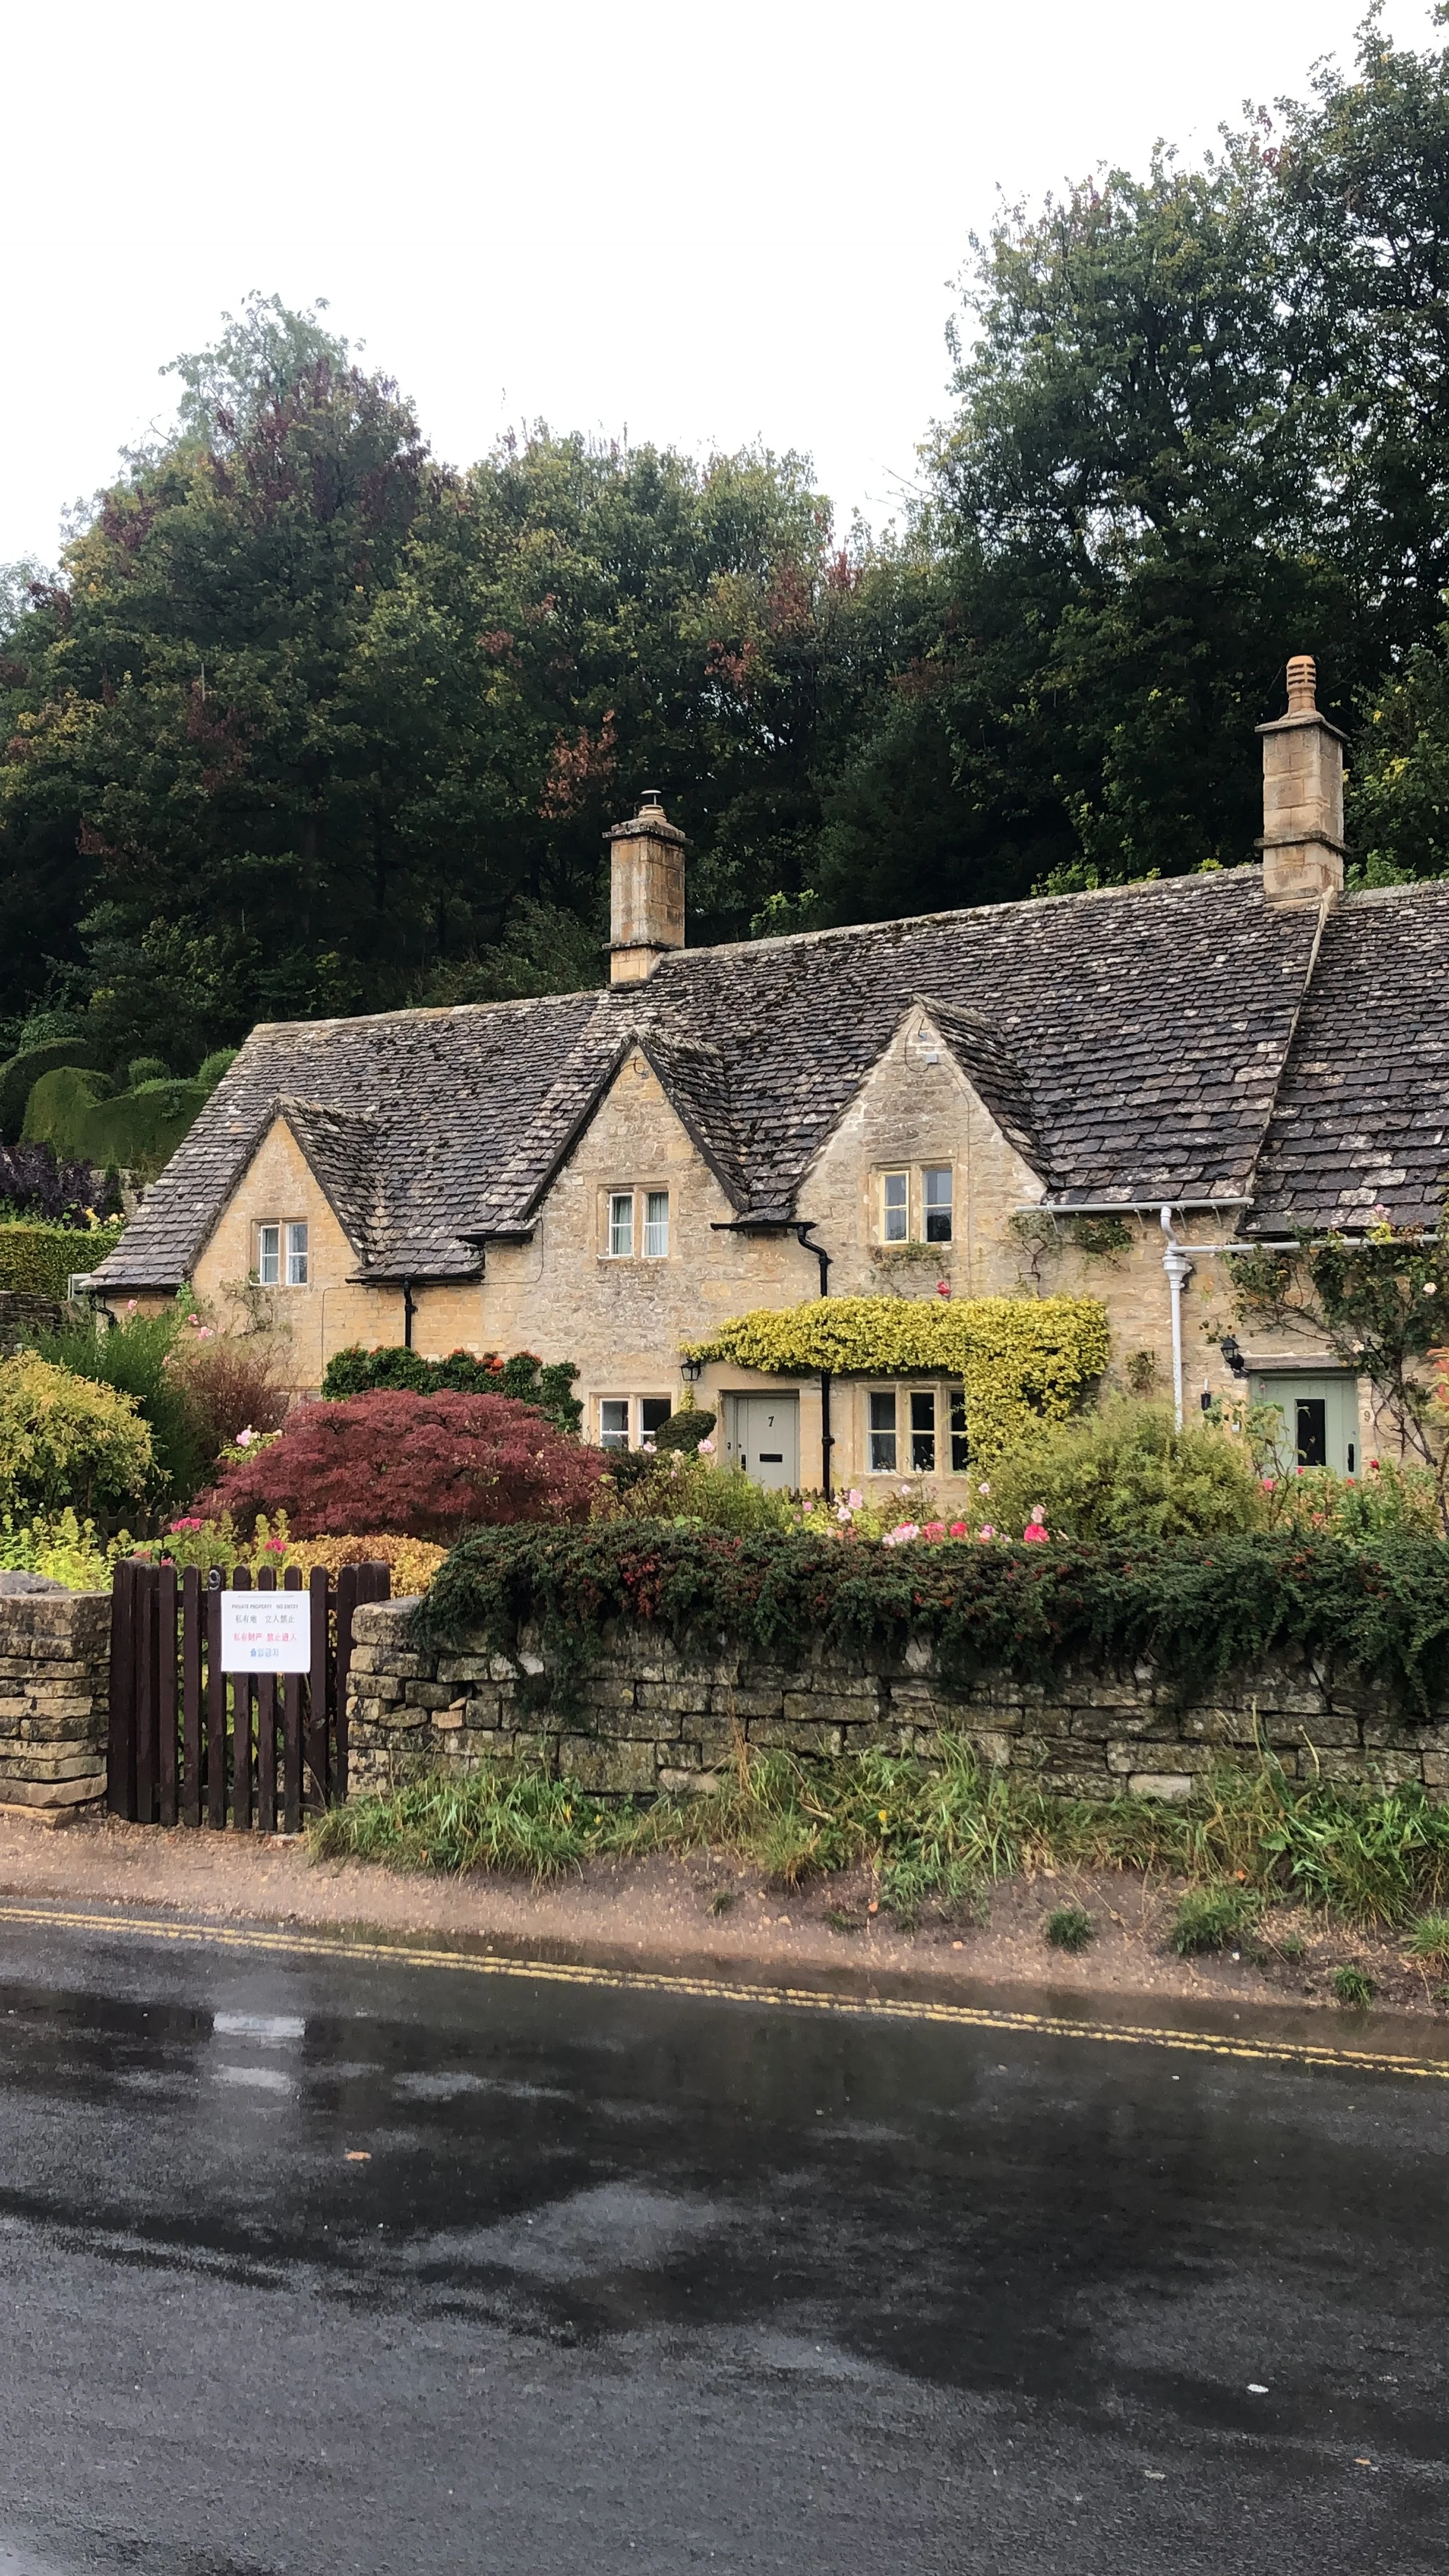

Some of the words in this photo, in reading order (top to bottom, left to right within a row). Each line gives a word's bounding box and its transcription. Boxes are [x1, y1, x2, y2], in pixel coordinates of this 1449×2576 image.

[768, 1415, 774, 1427] 7
[1364, 1410, 1371, 1422] 9
[209, 1569, 221, 1591] 9
